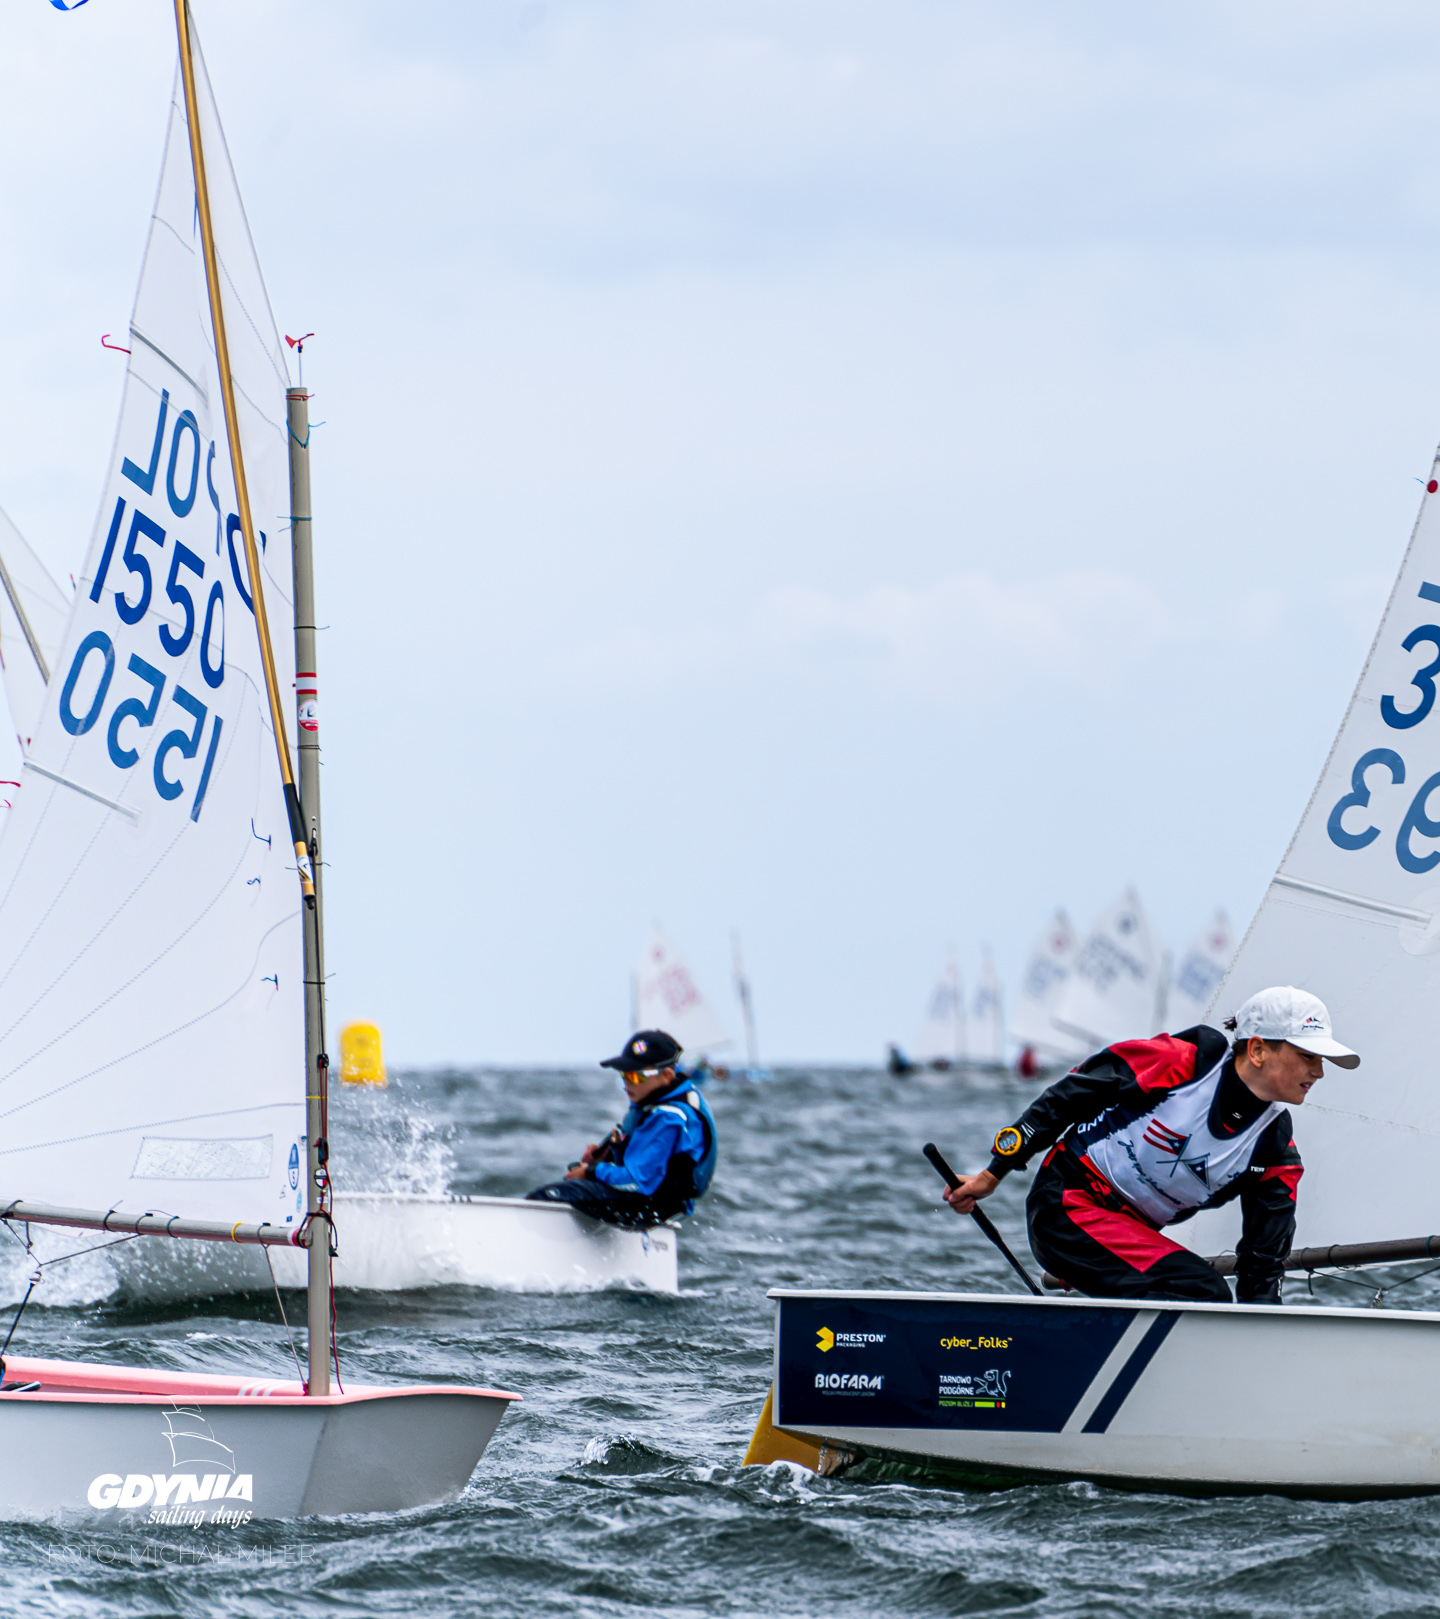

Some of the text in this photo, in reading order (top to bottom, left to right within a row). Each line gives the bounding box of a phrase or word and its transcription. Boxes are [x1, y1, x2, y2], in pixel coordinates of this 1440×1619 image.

[89, 497, 224, 689] 1550
[836, 1333, 883, 1342] PRESTON
[815, 1373, 881, 1390] BIOFARM
[939, 1375, 972, 1384] TARNOWO
[939, 1385, 974, 1396] PODGÓRNE
